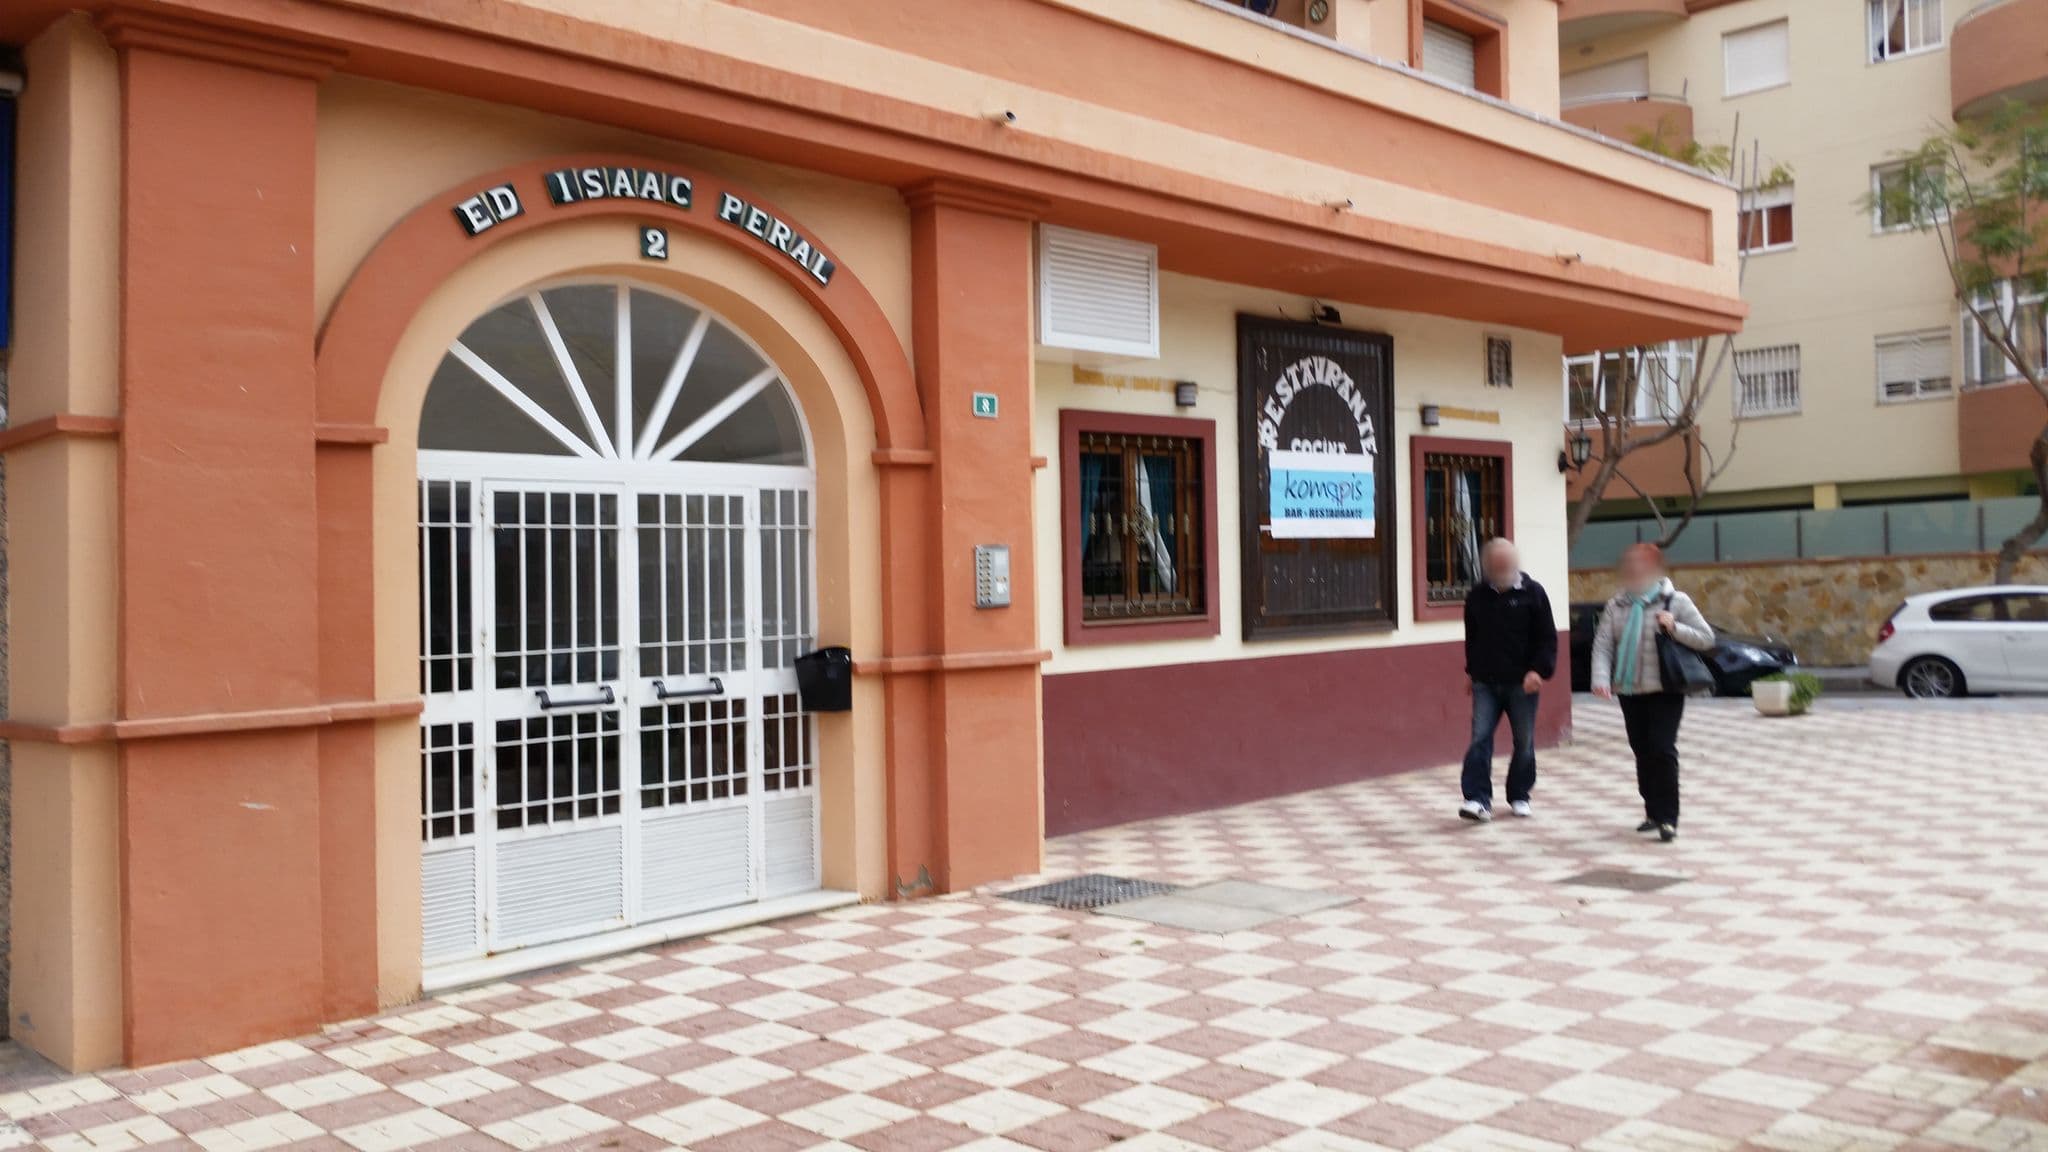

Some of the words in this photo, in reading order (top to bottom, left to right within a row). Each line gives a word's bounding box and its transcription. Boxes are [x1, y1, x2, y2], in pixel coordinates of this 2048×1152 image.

[458, 185, 520, 233] ED
[555, 170, 692, 206] ISAAC
[719, 193, 830, 283] PERAL
[645, 229, 667, 258] 2
